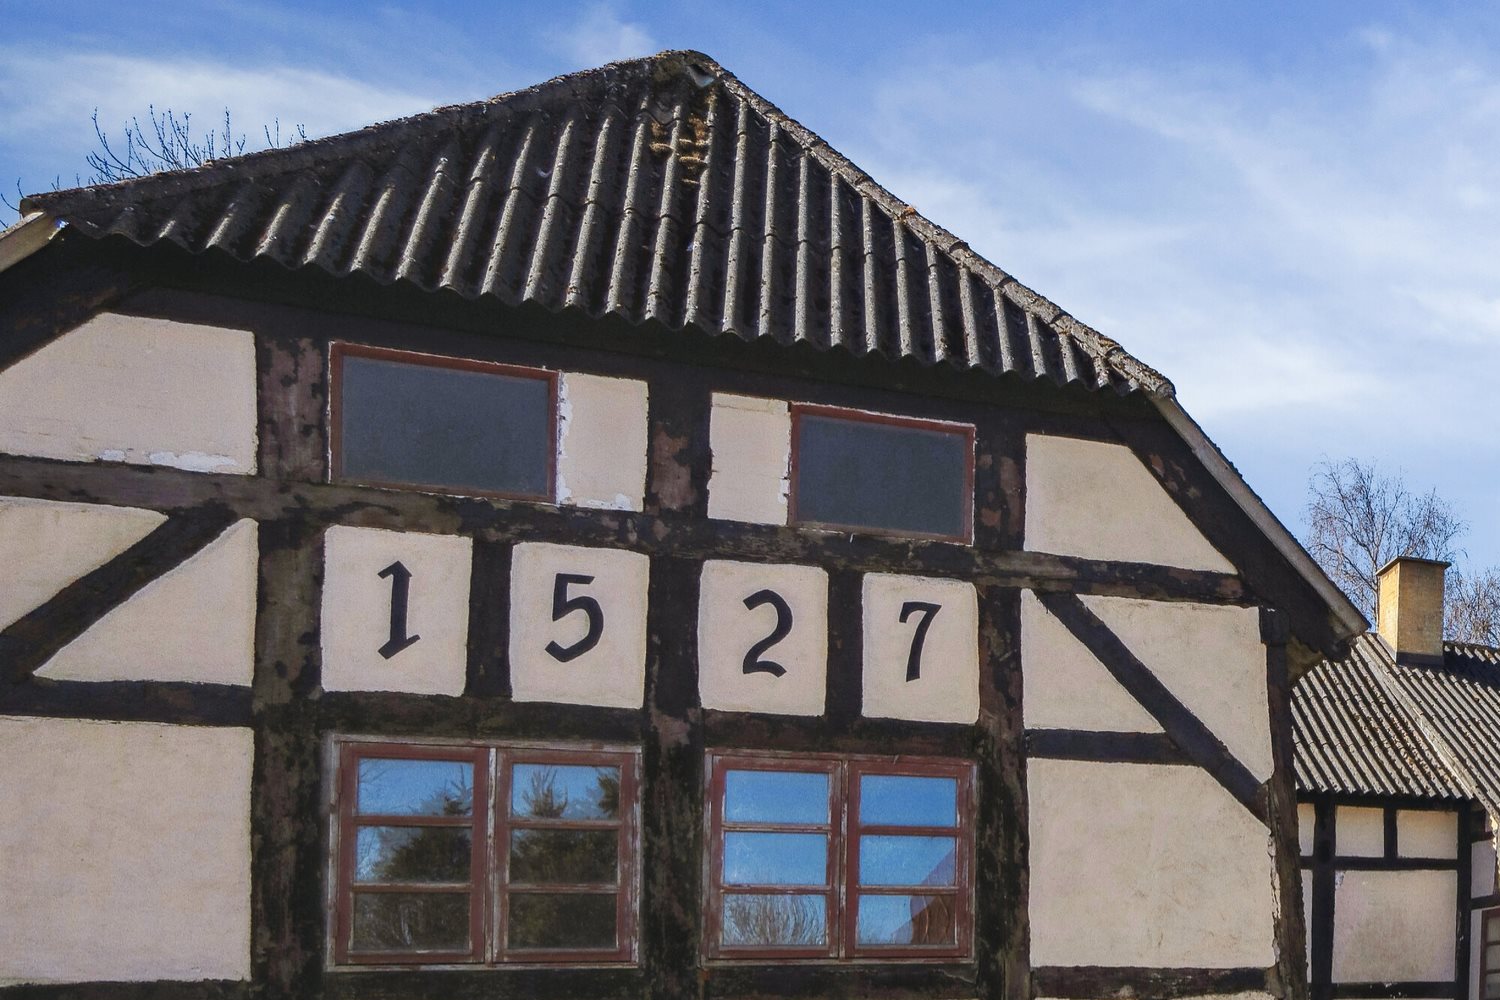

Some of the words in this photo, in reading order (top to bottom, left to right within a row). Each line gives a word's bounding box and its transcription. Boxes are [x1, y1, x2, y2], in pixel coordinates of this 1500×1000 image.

[376, 560, 421, 660] 1
[544, 572, 604, 663] 5
[741, 588, 793, 678] 2
[898, 601, 942, 683] 7
